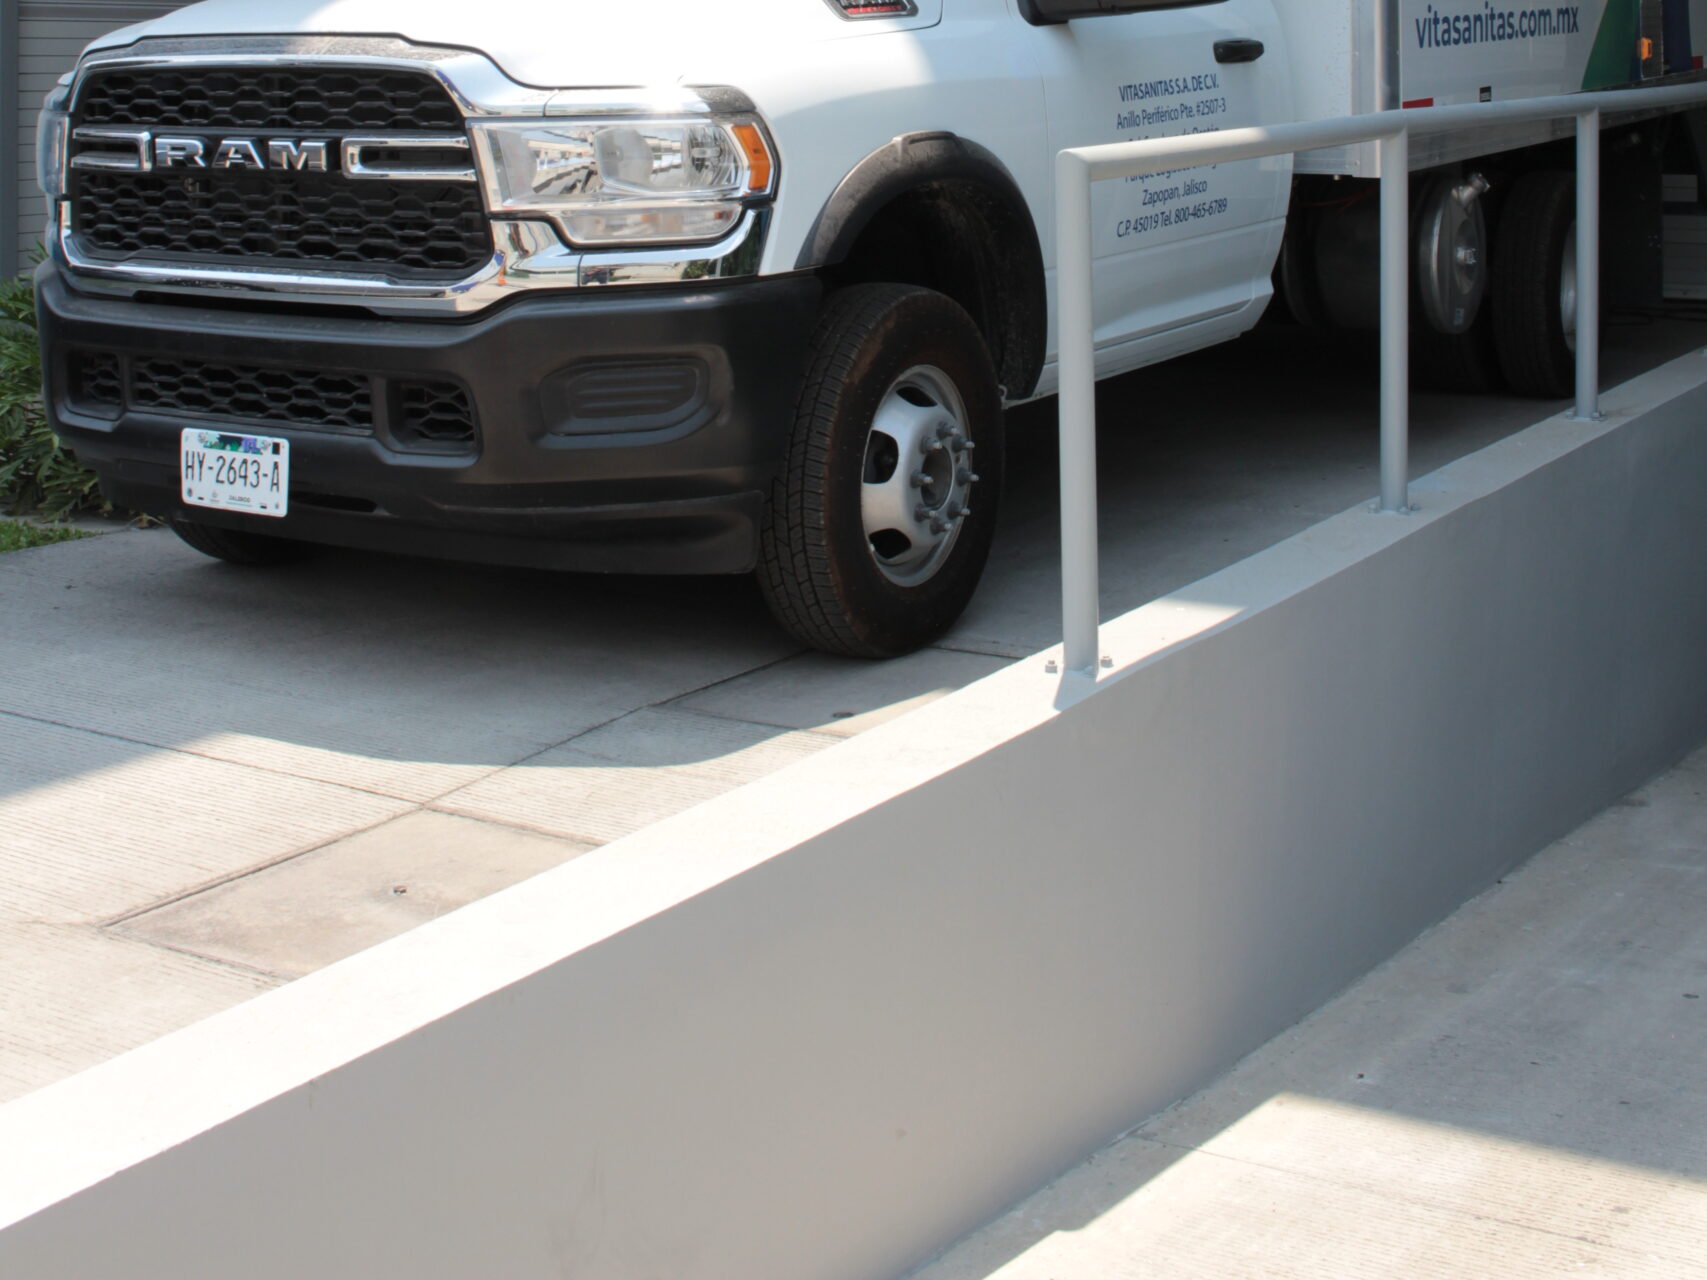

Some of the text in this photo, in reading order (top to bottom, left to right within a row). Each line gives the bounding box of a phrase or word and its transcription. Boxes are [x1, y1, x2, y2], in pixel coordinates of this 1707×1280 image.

[1415, 1, 1579, 49] vitasanitas.com.mx
[1118, 73, 1220, 102] VITASANITAS S.A. DE C.V.
[1116, 97, 1227, 130] Anillo Periférico Pte. #2507-3
[154, 135, 328, 173] RAM
[1141, 179, 1208, 207] Zapopan, Jalisco
[1132, 214, 1159, 234] 45019
[1160, 209, 1173, 227] Tel.
[1174, 197, 1228, 223] 800-465-6789
[185, 450, 280, 494] HY-2643-A
